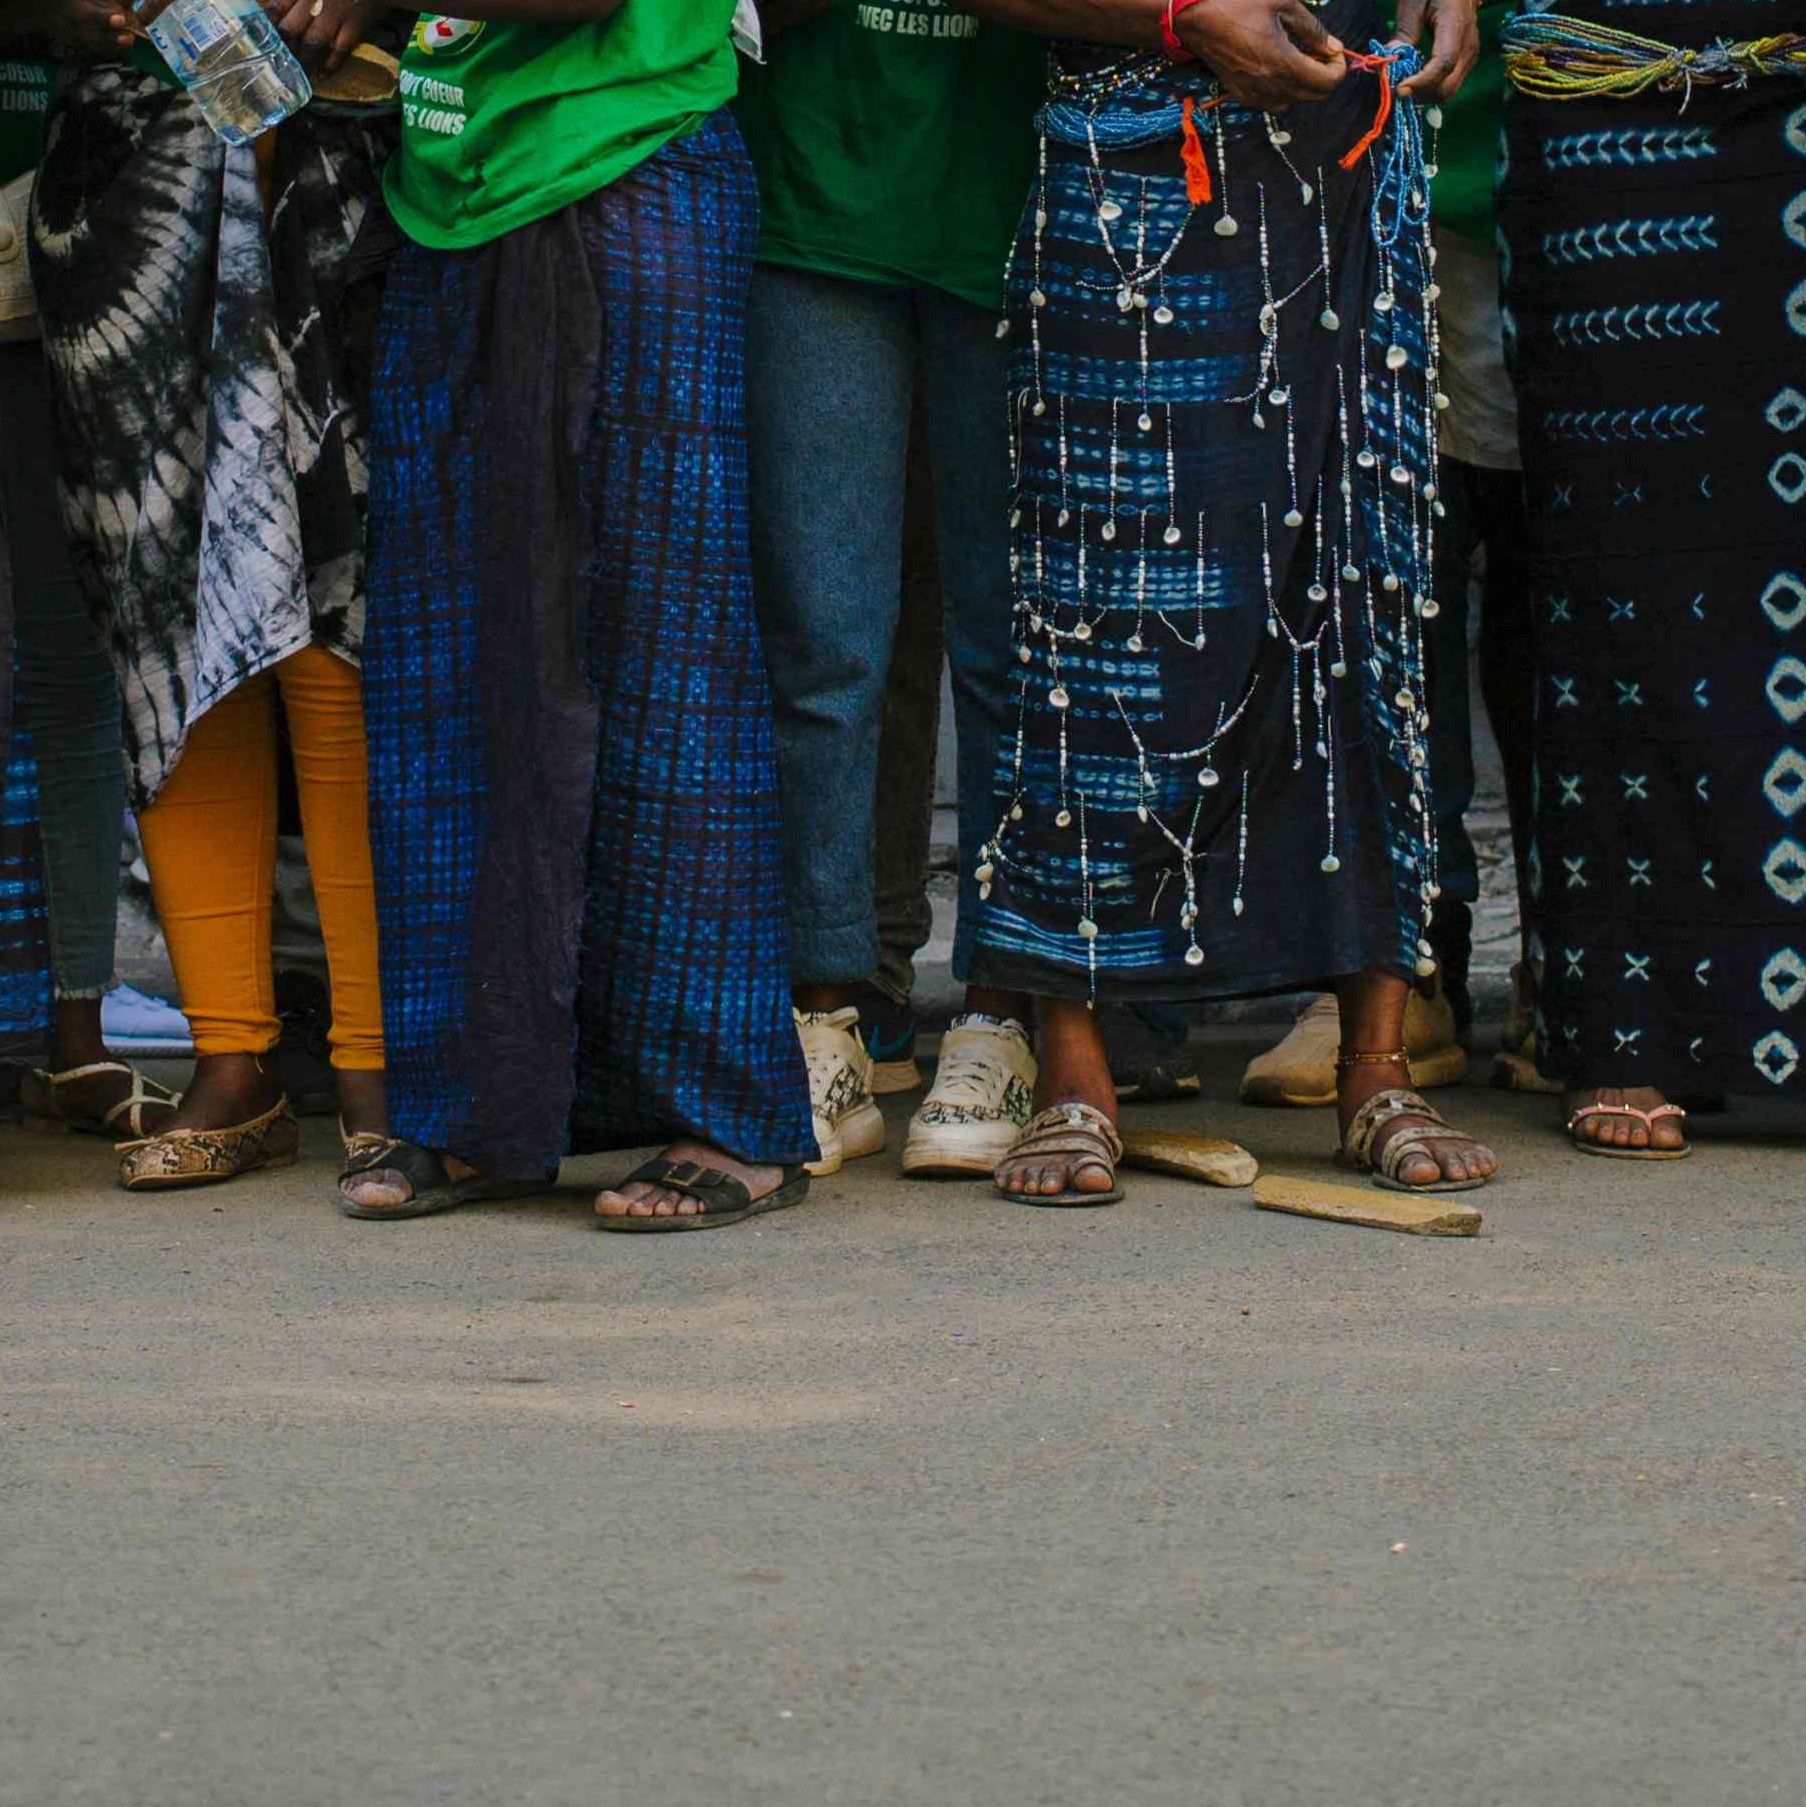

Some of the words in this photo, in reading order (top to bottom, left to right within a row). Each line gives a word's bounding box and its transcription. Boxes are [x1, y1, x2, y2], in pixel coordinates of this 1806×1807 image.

[895, 10, 930, 37] LES
[932, 13, 979, 39] LION
[421, 77, 465, 107] COEUR
[417, 107, 467, 136] LIONS
